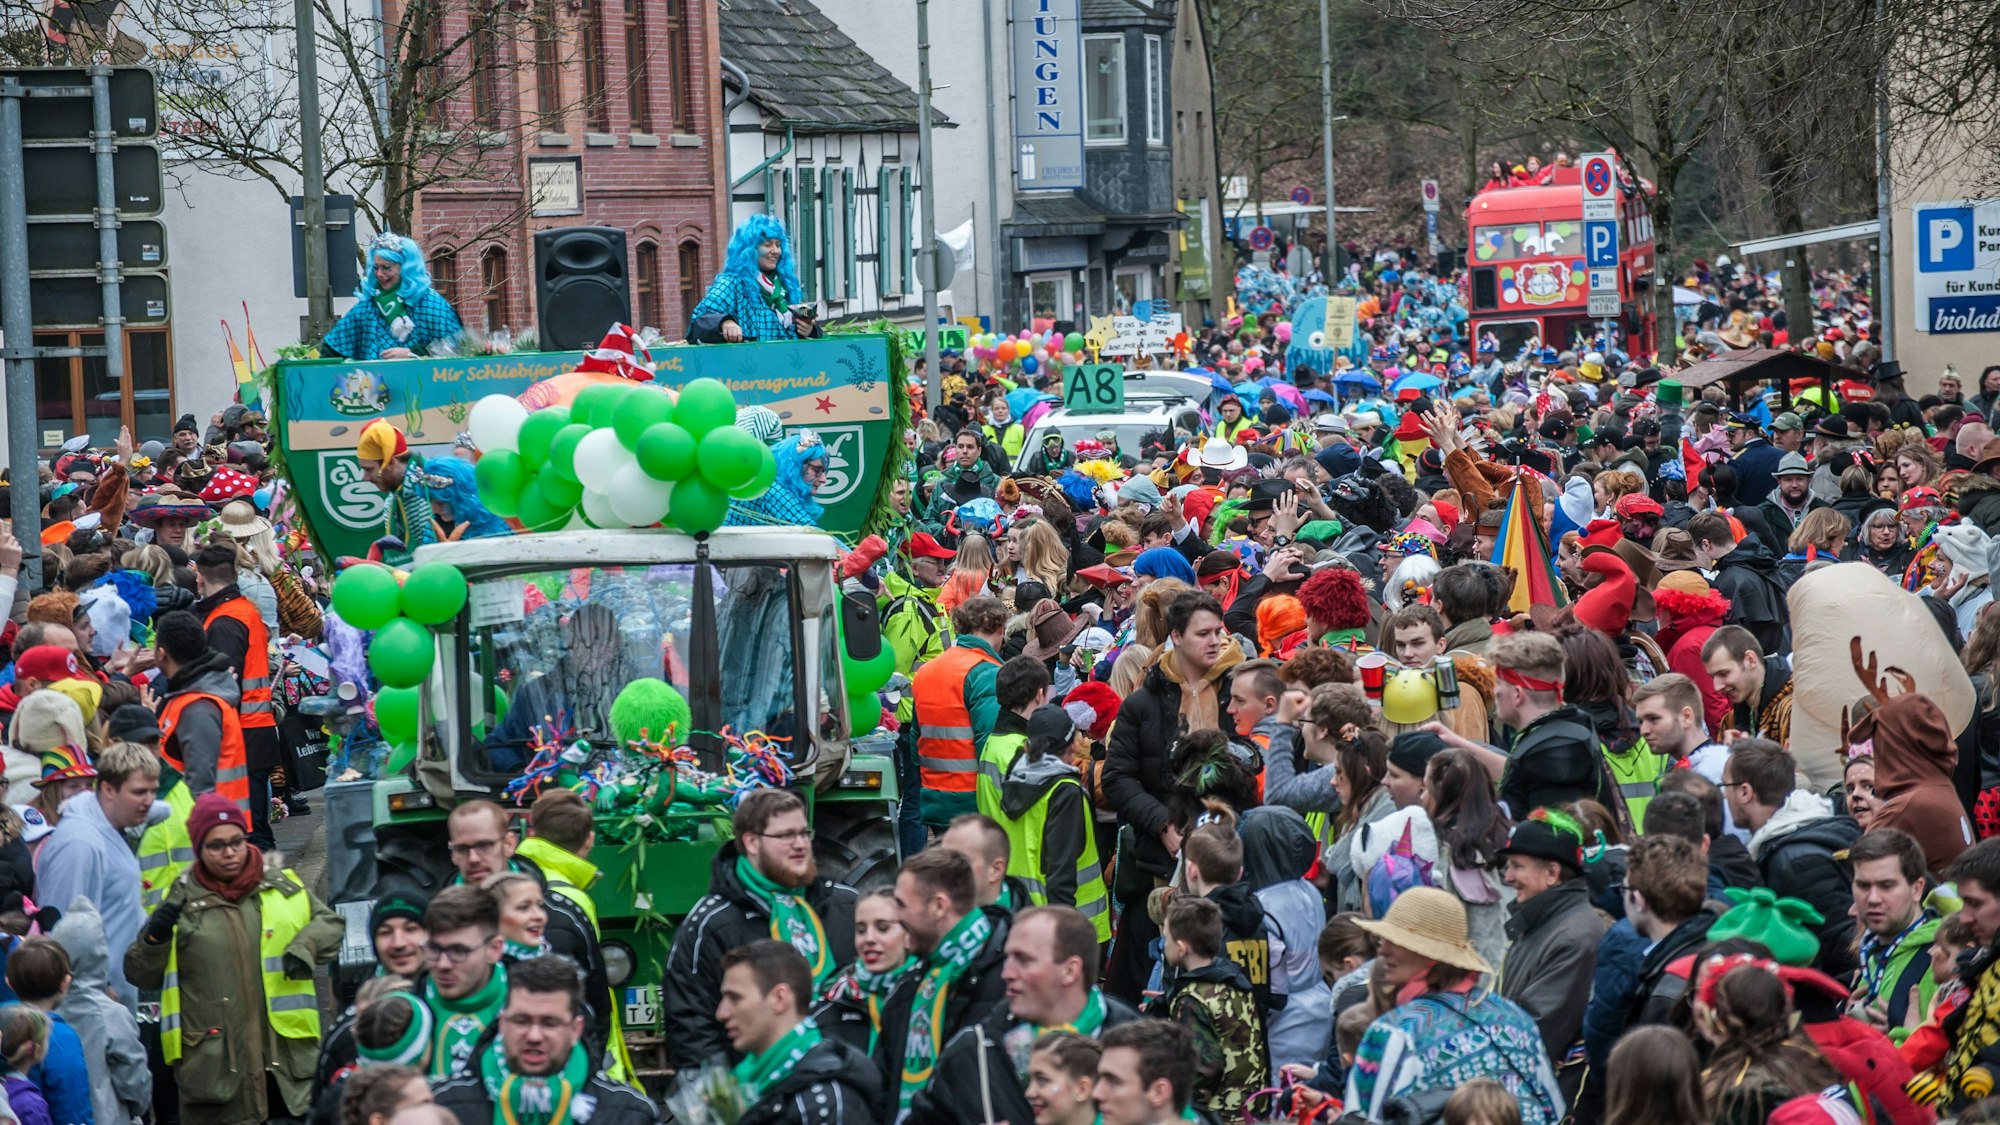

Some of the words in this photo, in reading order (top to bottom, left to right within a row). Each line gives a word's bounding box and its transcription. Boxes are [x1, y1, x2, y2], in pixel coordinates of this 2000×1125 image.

[1592, 226, 1611, 262] P
[1929, 218, 1963, 262] P
[1946, 280, 1965, 293] für
[432, 366, 465, 383] Mir
[1066, 367, 1117, 405] A8
[1226, 939, 1268, 985] FBI
